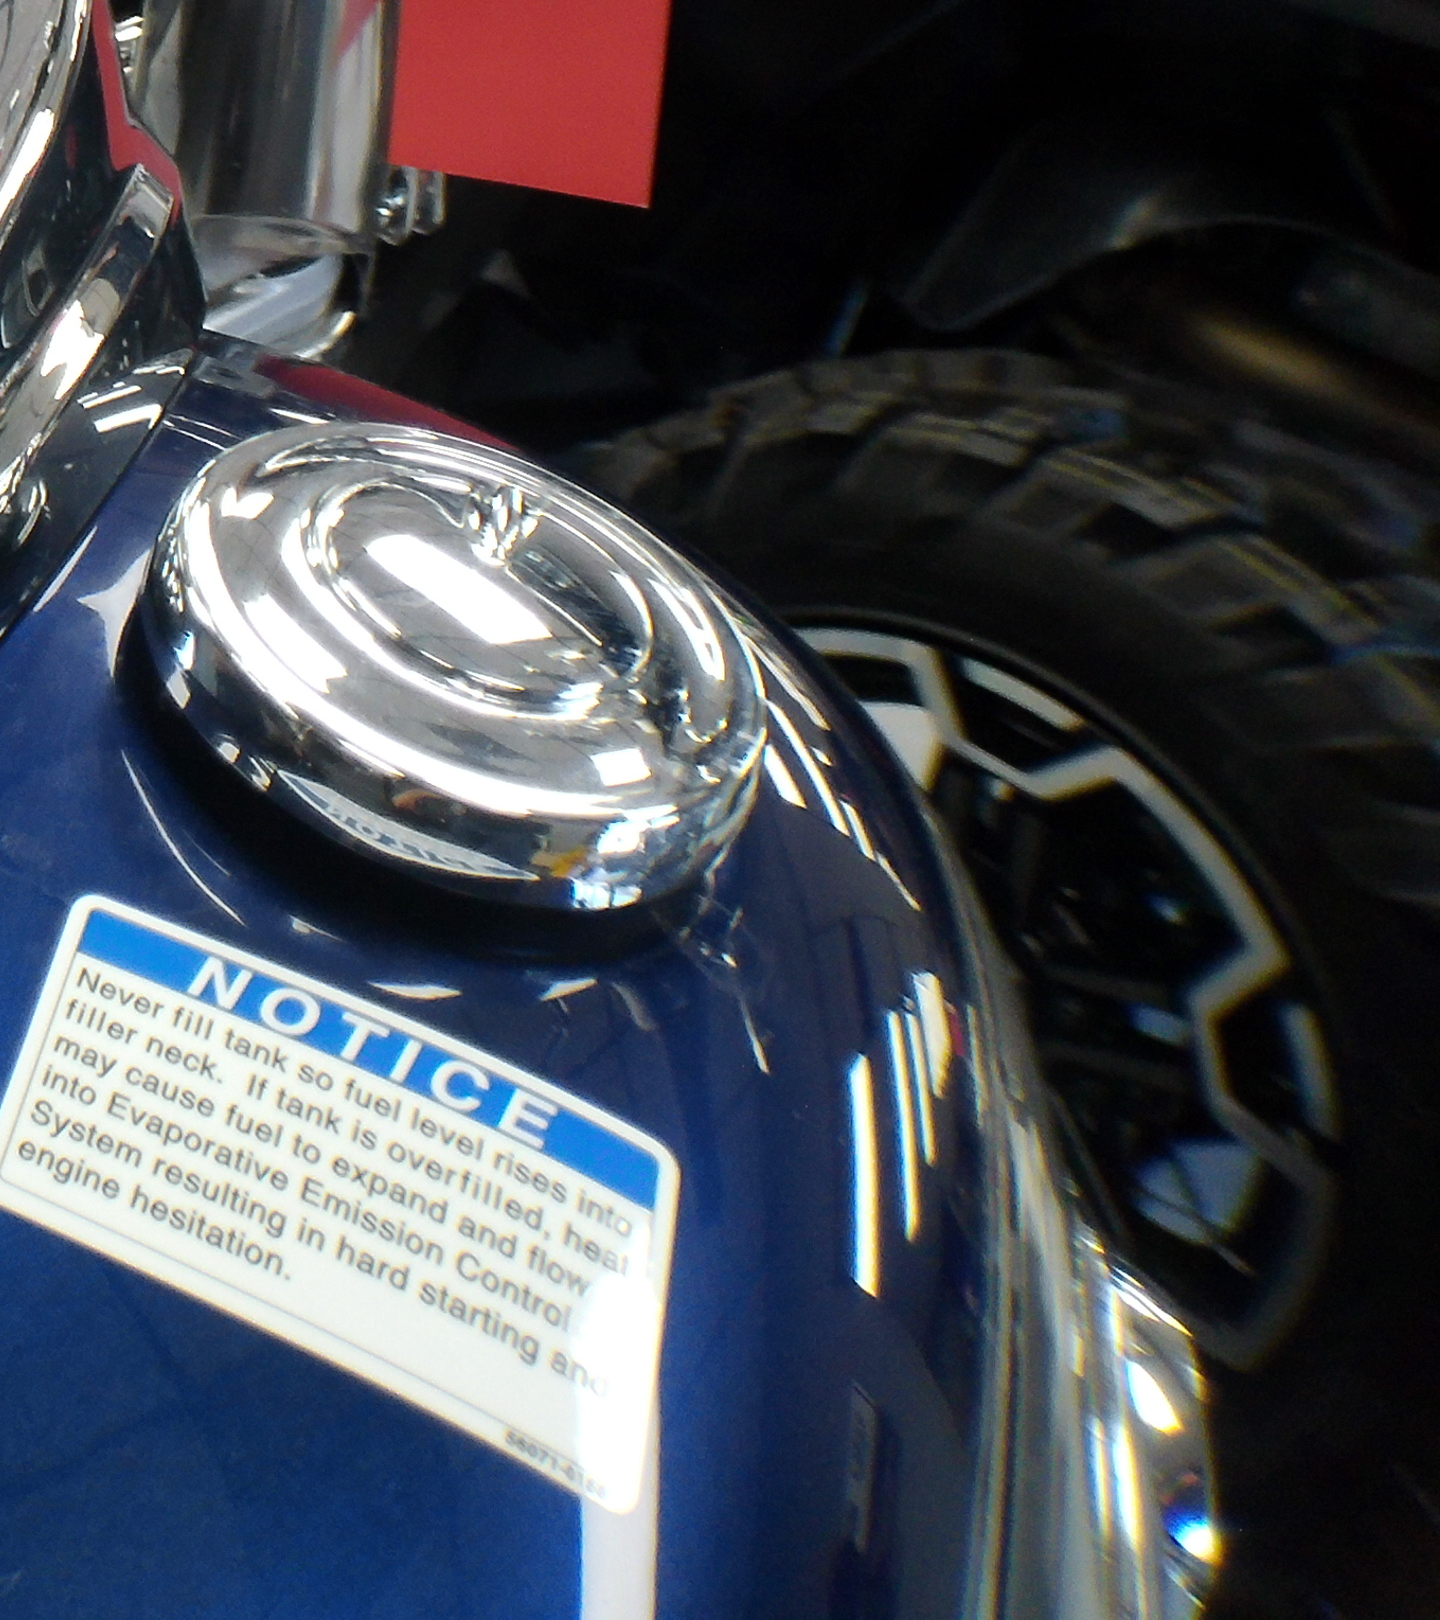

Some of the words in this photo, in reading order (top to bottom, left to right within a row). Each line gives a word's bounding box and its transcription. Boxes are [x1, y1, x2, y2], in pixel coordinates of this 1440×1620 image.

[53, 1034, 118, 1079] may
[125, 1065, 216, 1118] cause
[224, 1104, 284, 1148] fuel
[292, 1132, 323, 1165] to
[332, 1155, 449, 1226] expand
[457, 1216, 518, 1260] and
[527, 1242, 591, 1298] flow
[66, 998, 138, 1045] filler
[145, 1036, 224, 1085] neck.
[246, 1073, 268, 1101] If
[276, 1086, 341, 1135] tank
[349, 1119, 378, 1151] is
[563, 1221, 630, 1276] heat
[77, 967, 165, 1019] Never
[172, 1006, 215, 1041] fill
[224, 1027, 290, 1073] tank
[298, 1064, 334, 1091] so
[344, 1078, 402, 1122] fuel
[410, 1107, 485, 1160] level
[493, 1151, 568, 1204] rises
[576, 1188, 633, 1239] into
[186, 956, 558, 1151] NOTICE
[18, 1139, 121, 1200] engine
[130, 1183, 291, 1281] hesitation.
[30, 1098, 143, 1169] System
[152, 1155, 288, 1238] resulting
[296, 1217, 327, 1252] in
[335, 1236, 412, 1291] hard
[418, 1281, 541, 1366] starting
[41, 1064, 98, 1107] into
[107, 1091, 290, 1191] Evaporative
[299, 1175, 445, 1266] Emission
[456, 1250, 573, 1332] Control
